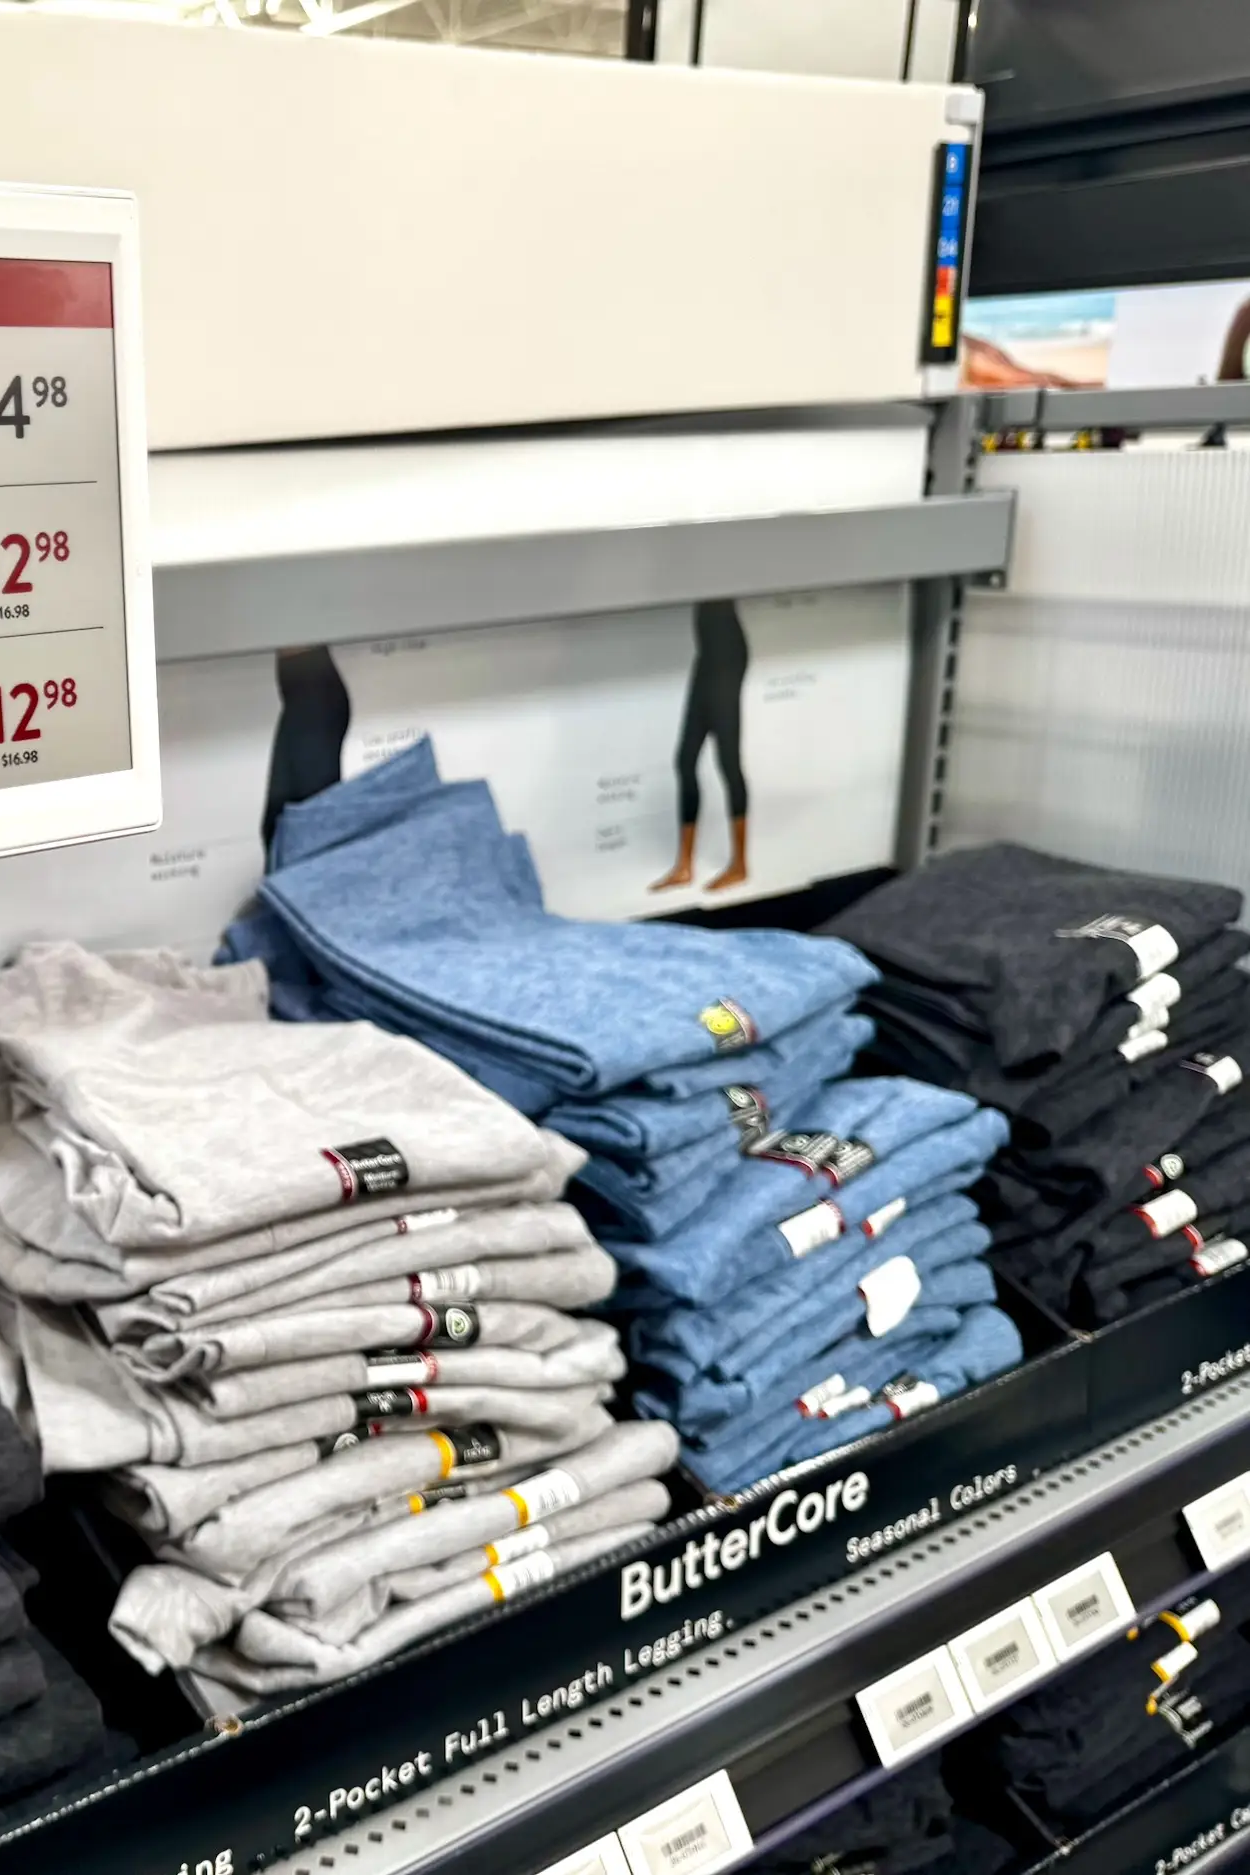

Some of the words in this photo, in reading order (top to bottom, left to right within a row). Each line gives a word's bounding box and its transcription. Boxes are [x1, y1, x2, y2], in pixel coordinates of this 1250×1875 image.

[0, 750, 39, 769] $16.98
[620, 1470, 870, 1622] ButterCore
[846, 1497, 941, 1563] Seasonal
[950, 1464, 1017, 1511] Colors
[294, 1750, 433, 1836] 2-Pocket
[445, 1710, 510, 1764] Full
[521, 1660, 615, 1727] Length
[623, 1607, 735, 1674] Legging.
